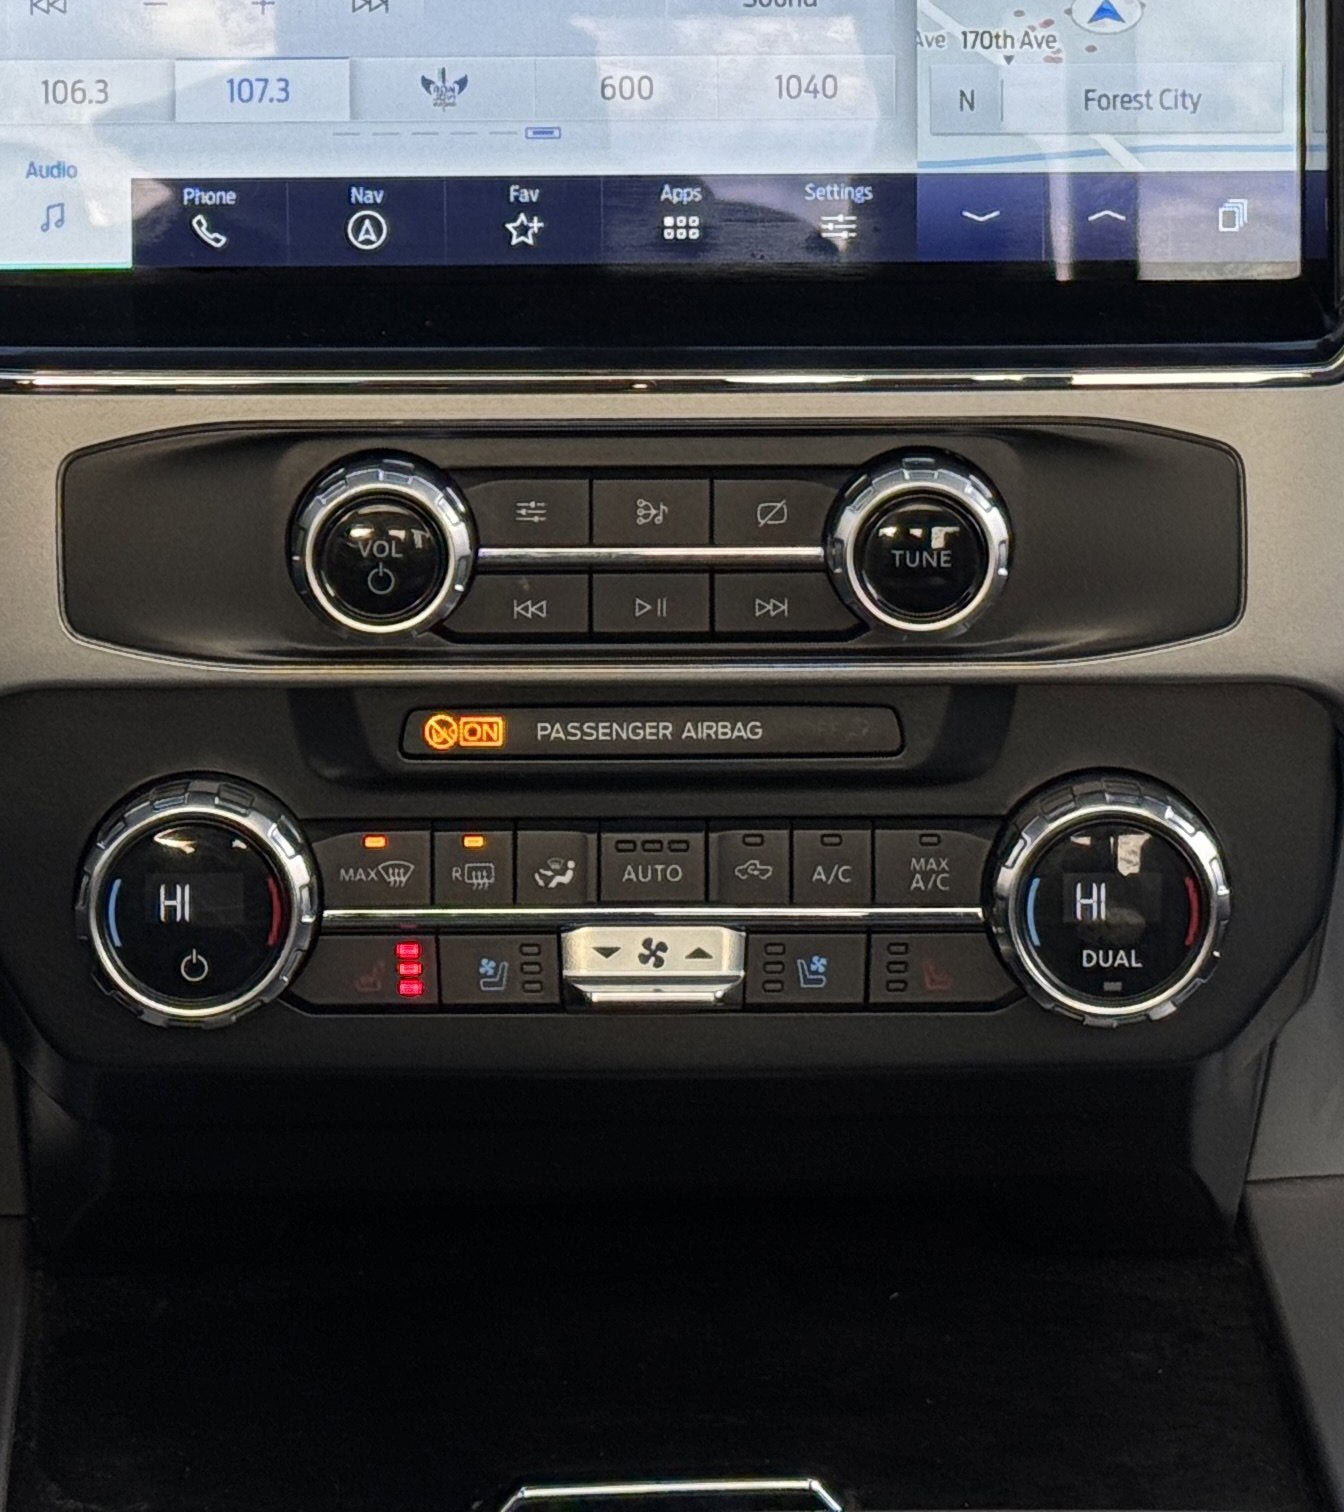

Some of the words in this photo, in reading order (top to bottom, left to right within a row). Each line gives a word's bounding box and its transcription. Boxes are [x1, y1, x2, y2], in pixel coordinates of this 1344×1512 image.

[961, 30, 1015, 50] 170th
[1020, 30, 1058, 50] Ave
[41, 78, 109, 105] 106.3
[226, 77, 290, 104] 107.3
[599, 75, 654, 102] 600
[775, 73, 838, 100] 1040
[959, 89, 975, 112] N
[1084, 88, 1153, 111] Forest
[1159, 88, 1202, 116] City
[25, 160, 78, 179] Audio
[183, 187, 237, 205] Phone
[350, 186, 384, 204] Nav
[509, 184, 540, 203] Fav
[660, 184, 703, 205] Apps
[805, 183, 873, 204] Settings
[358, 540, 403, 558] VOL
[891, 550, 951, 568] TUNE
[463, 723, 500, 742] ON
[537, 721, 673, 741] PASSENGER
[681, 721, 763, 740] AIRBAG
[451, 866, 462, 881] R
[622, 864, 683, 882] AUTO
[910, 857, 949, 871] MAX
[340, 868, 378, 881] MAX
[812, 864, 851, 885] A/C
[910, 873, 950, 891] A/C
[159, 884, 190, 922] HI
[1075, 882, 1107, 922] HI
[1082, 949, 1143, 968] DUAL
